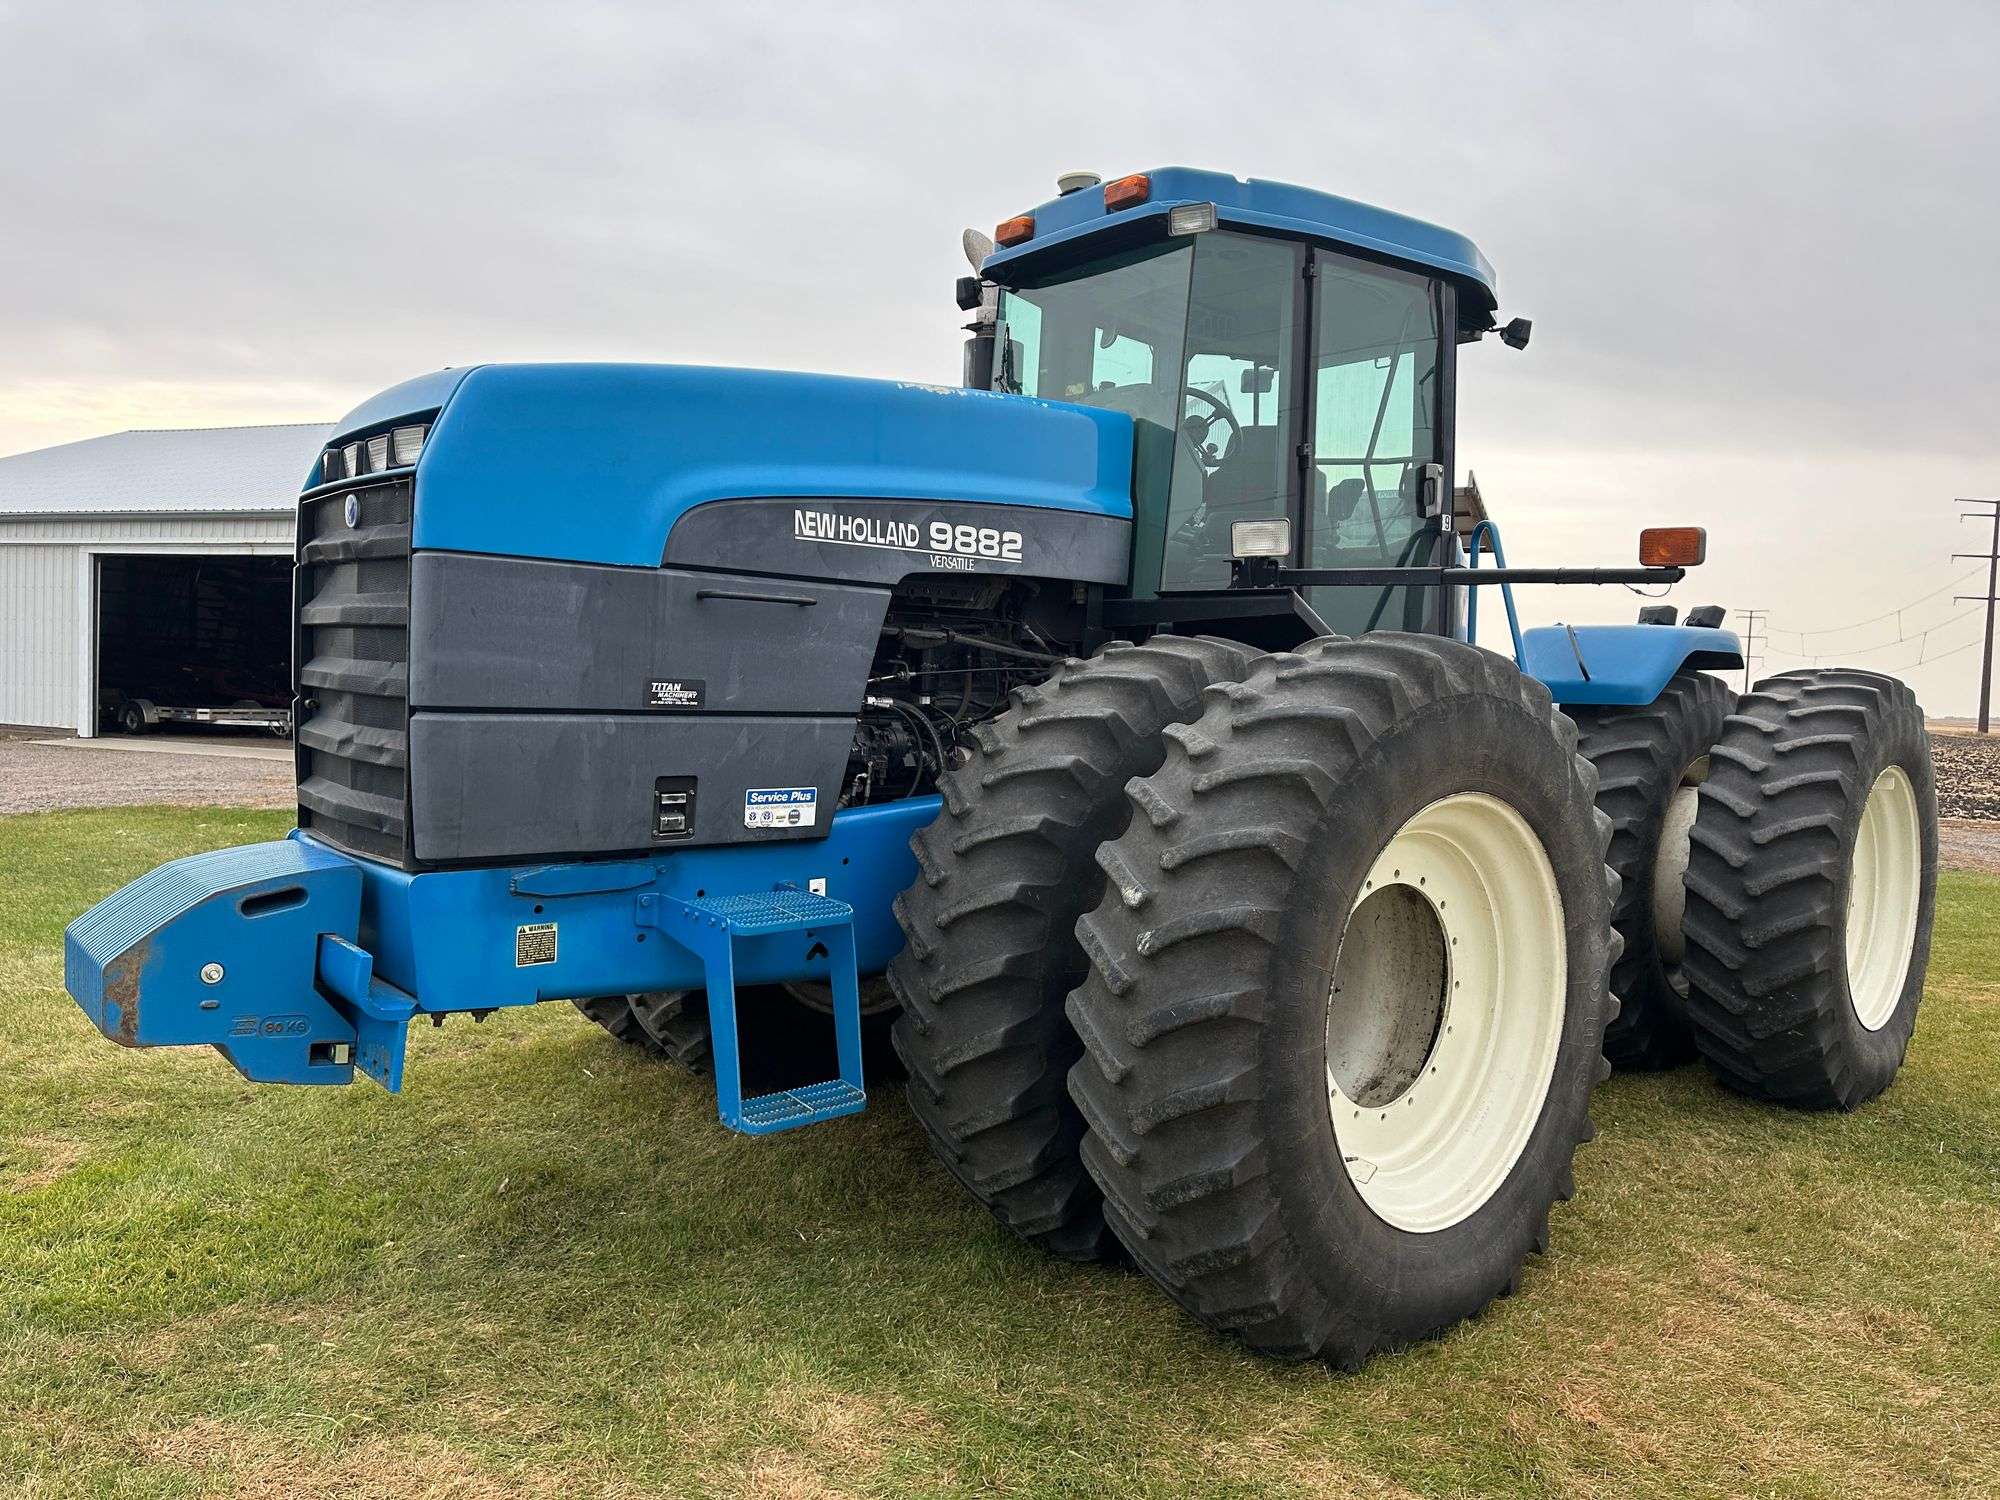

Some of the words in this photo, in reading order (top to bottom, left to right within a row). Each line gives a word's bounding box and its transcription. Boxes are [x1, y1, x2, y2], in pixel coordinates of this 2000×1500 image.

[794, 509, 836, 540] NEW
[839, 515, 920, 547] HOLLAND
[929, 521, 1023, 560] 9882
[929, 554, 975, 571] VERSATILE
[651, 682, 682, 692] TITAN
[750, 791, 788, 803] Service
[790, 791, 812, 801] Plus
[528, 924, 554, 932] WARNING
